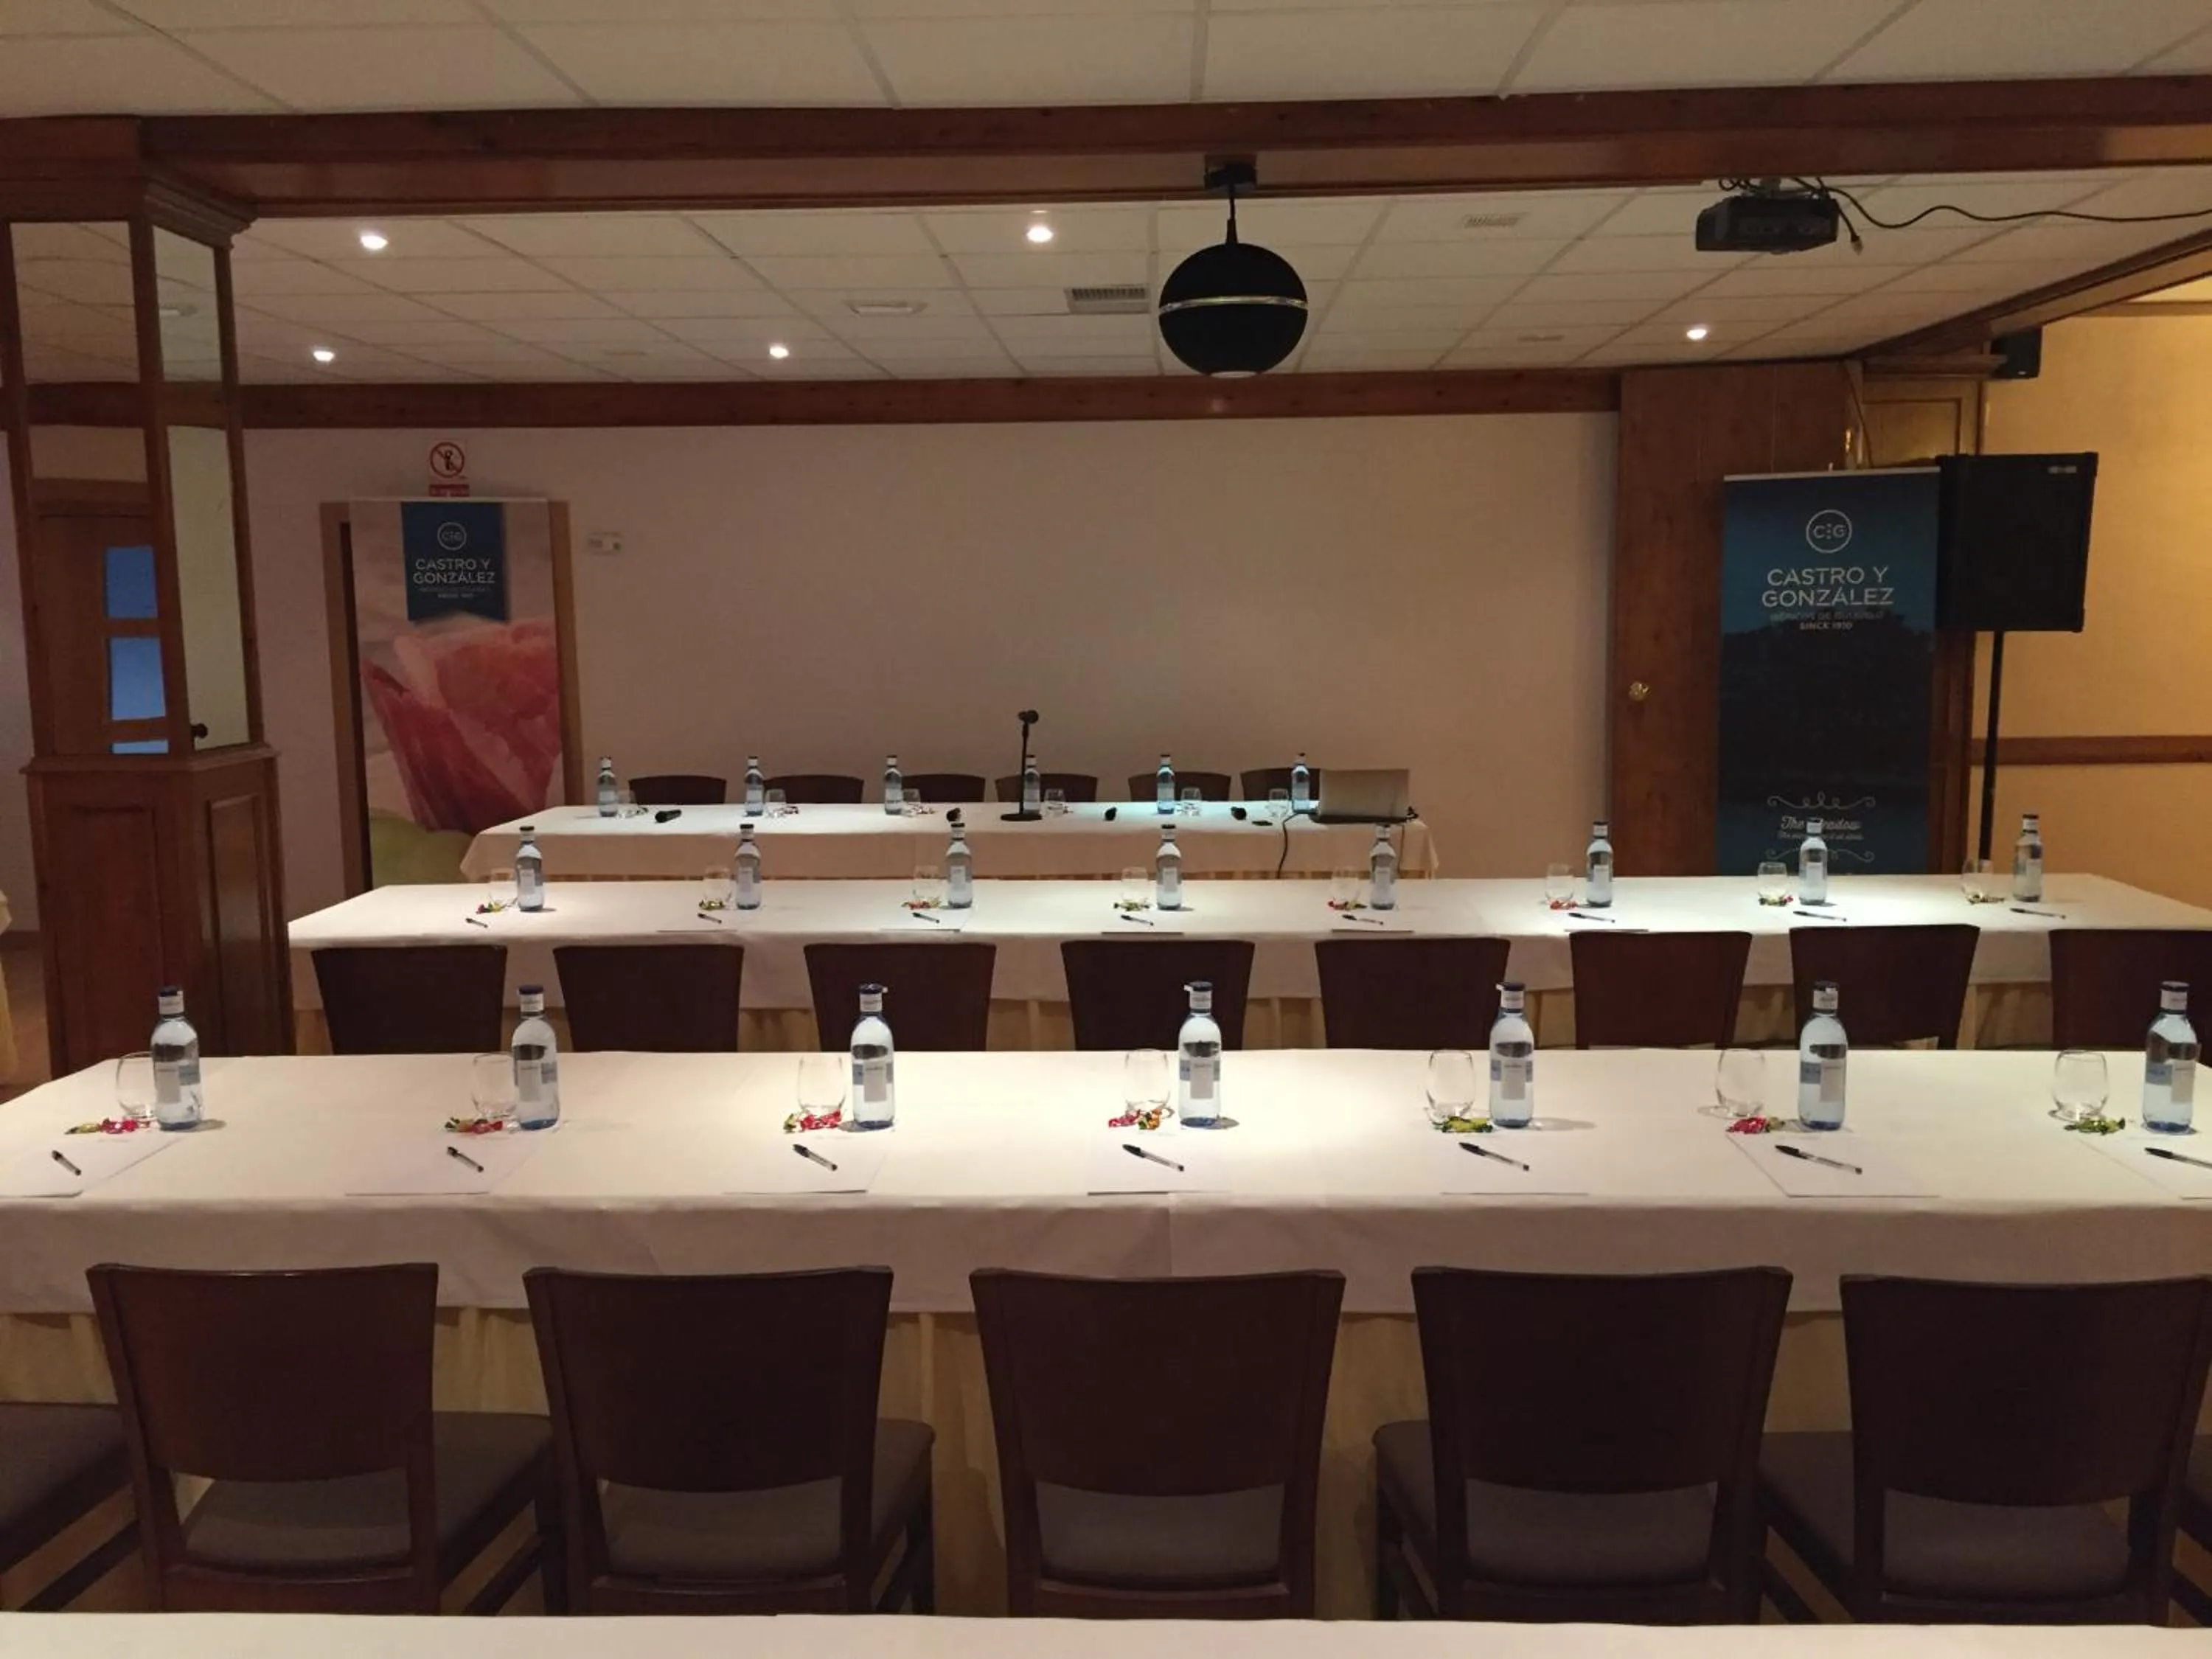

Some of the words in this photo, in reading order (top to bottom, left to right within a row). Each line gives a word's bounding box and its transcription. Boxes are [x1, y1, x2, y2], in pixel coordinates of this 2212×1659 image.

[415, 558, 477, 571] CASTRO
[481, 558, 491, 570] Y
[412, 570, 495, 584] GONZÁLEZ
[1767, 566, 1865, 587] CASTRO
[1873, 565, 1889, 583] Y
[1761, 587, 1895, 608] GONZÁLEZ
